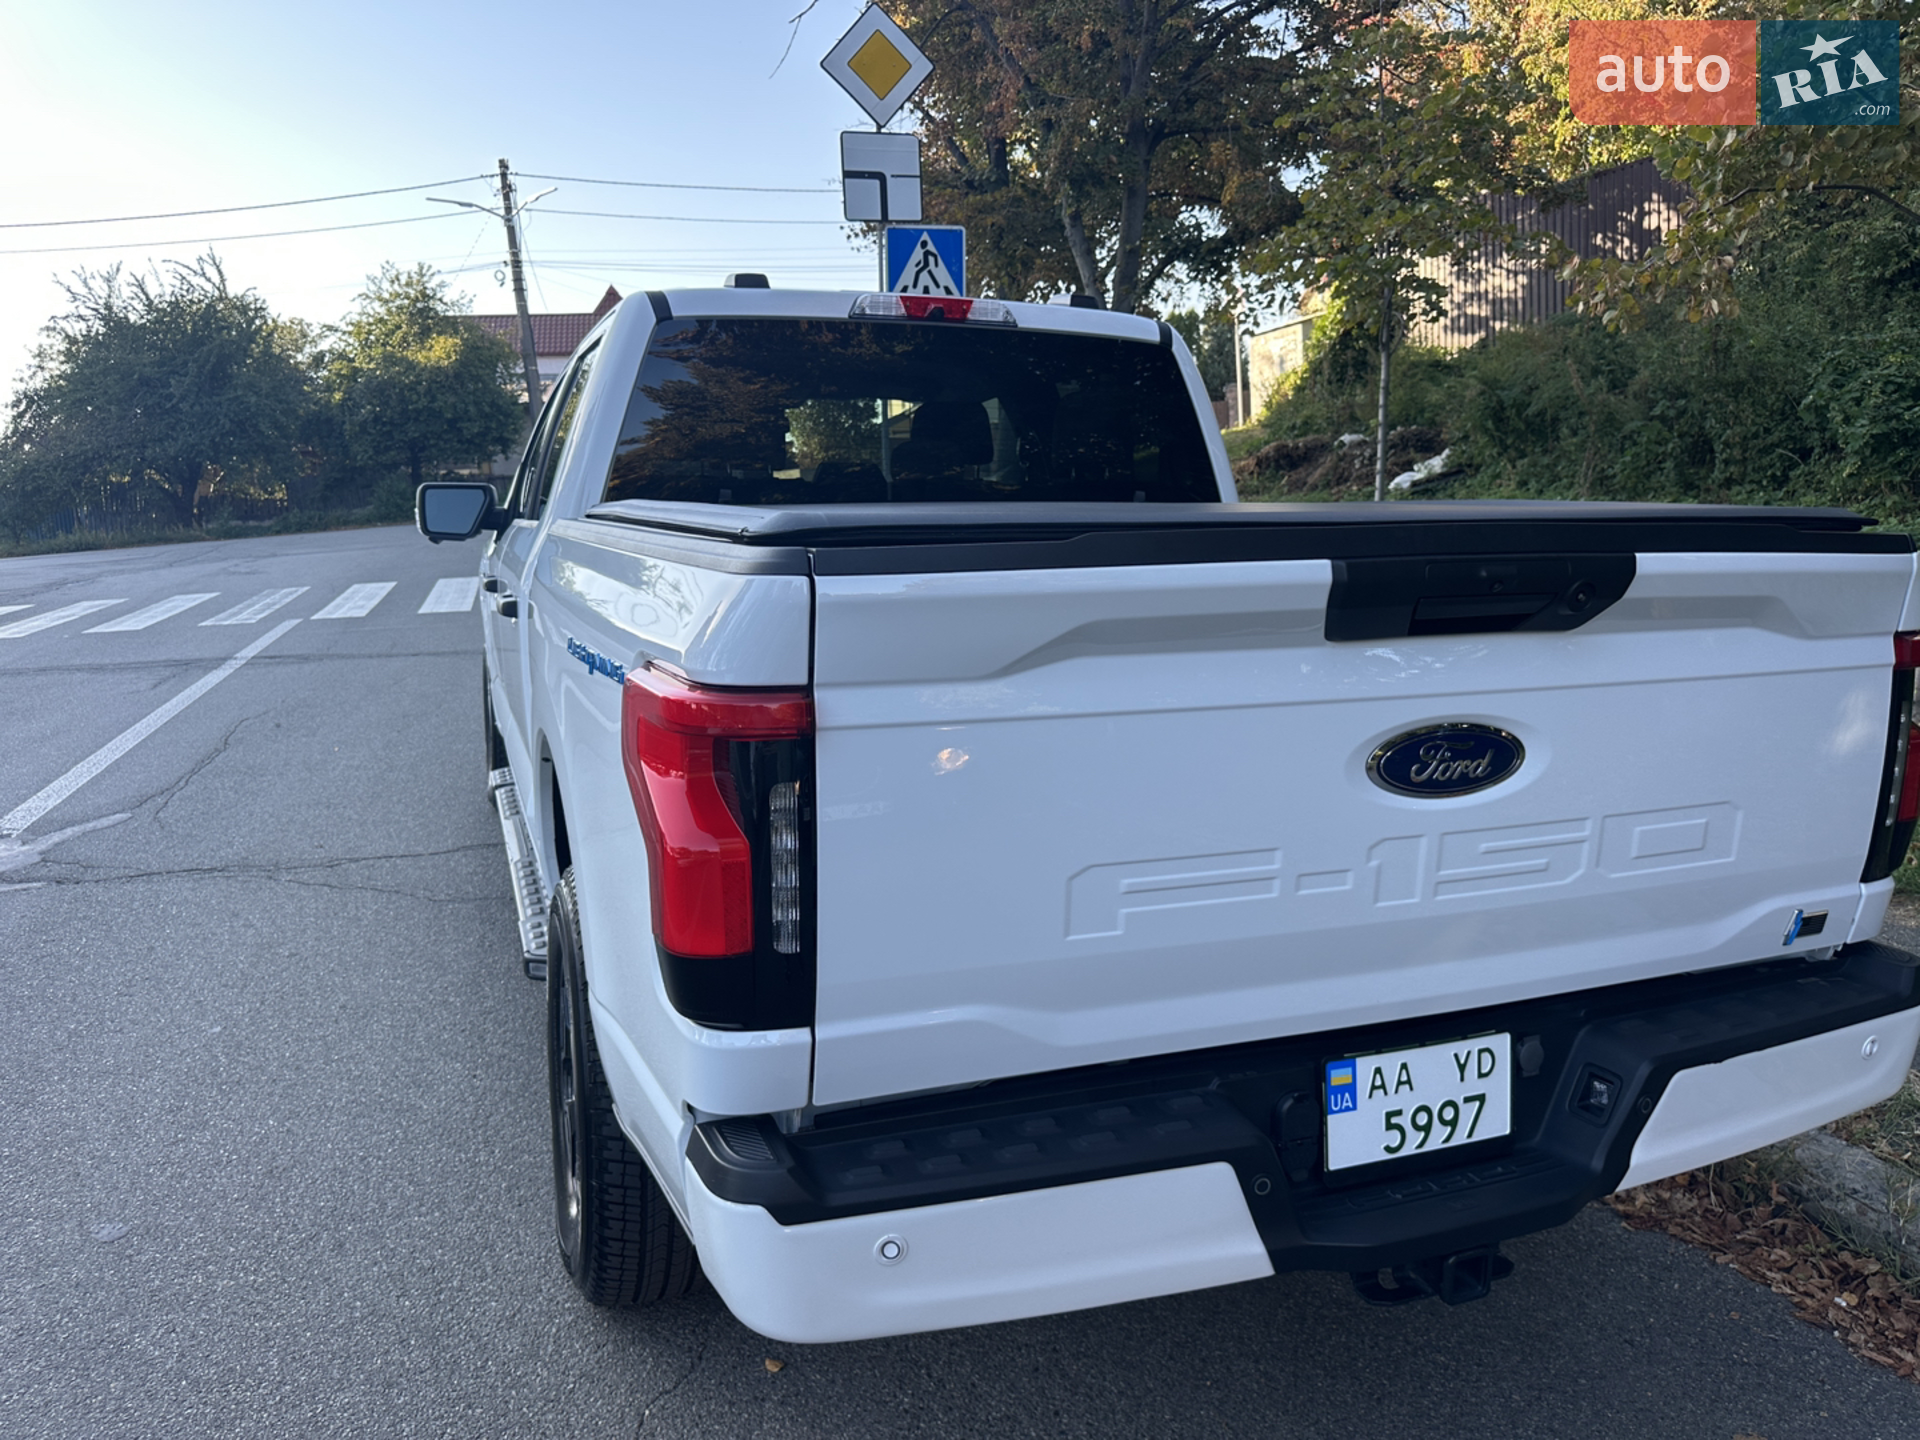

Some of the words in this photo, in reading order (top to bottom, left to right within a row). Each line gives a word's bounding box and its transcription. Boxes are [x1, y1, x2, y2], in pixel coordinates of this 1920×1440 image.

[1410, 741, 1496, 783] Ford
[1065, 801, 1743, 941] F-150
[1367, 1061, 1414, 1100] AA
[1453, 1047, 1496, 1083] YD
[1330, 1092, 1353, 1111] UA
[1381, 1093, 1487, 1154] 5997
